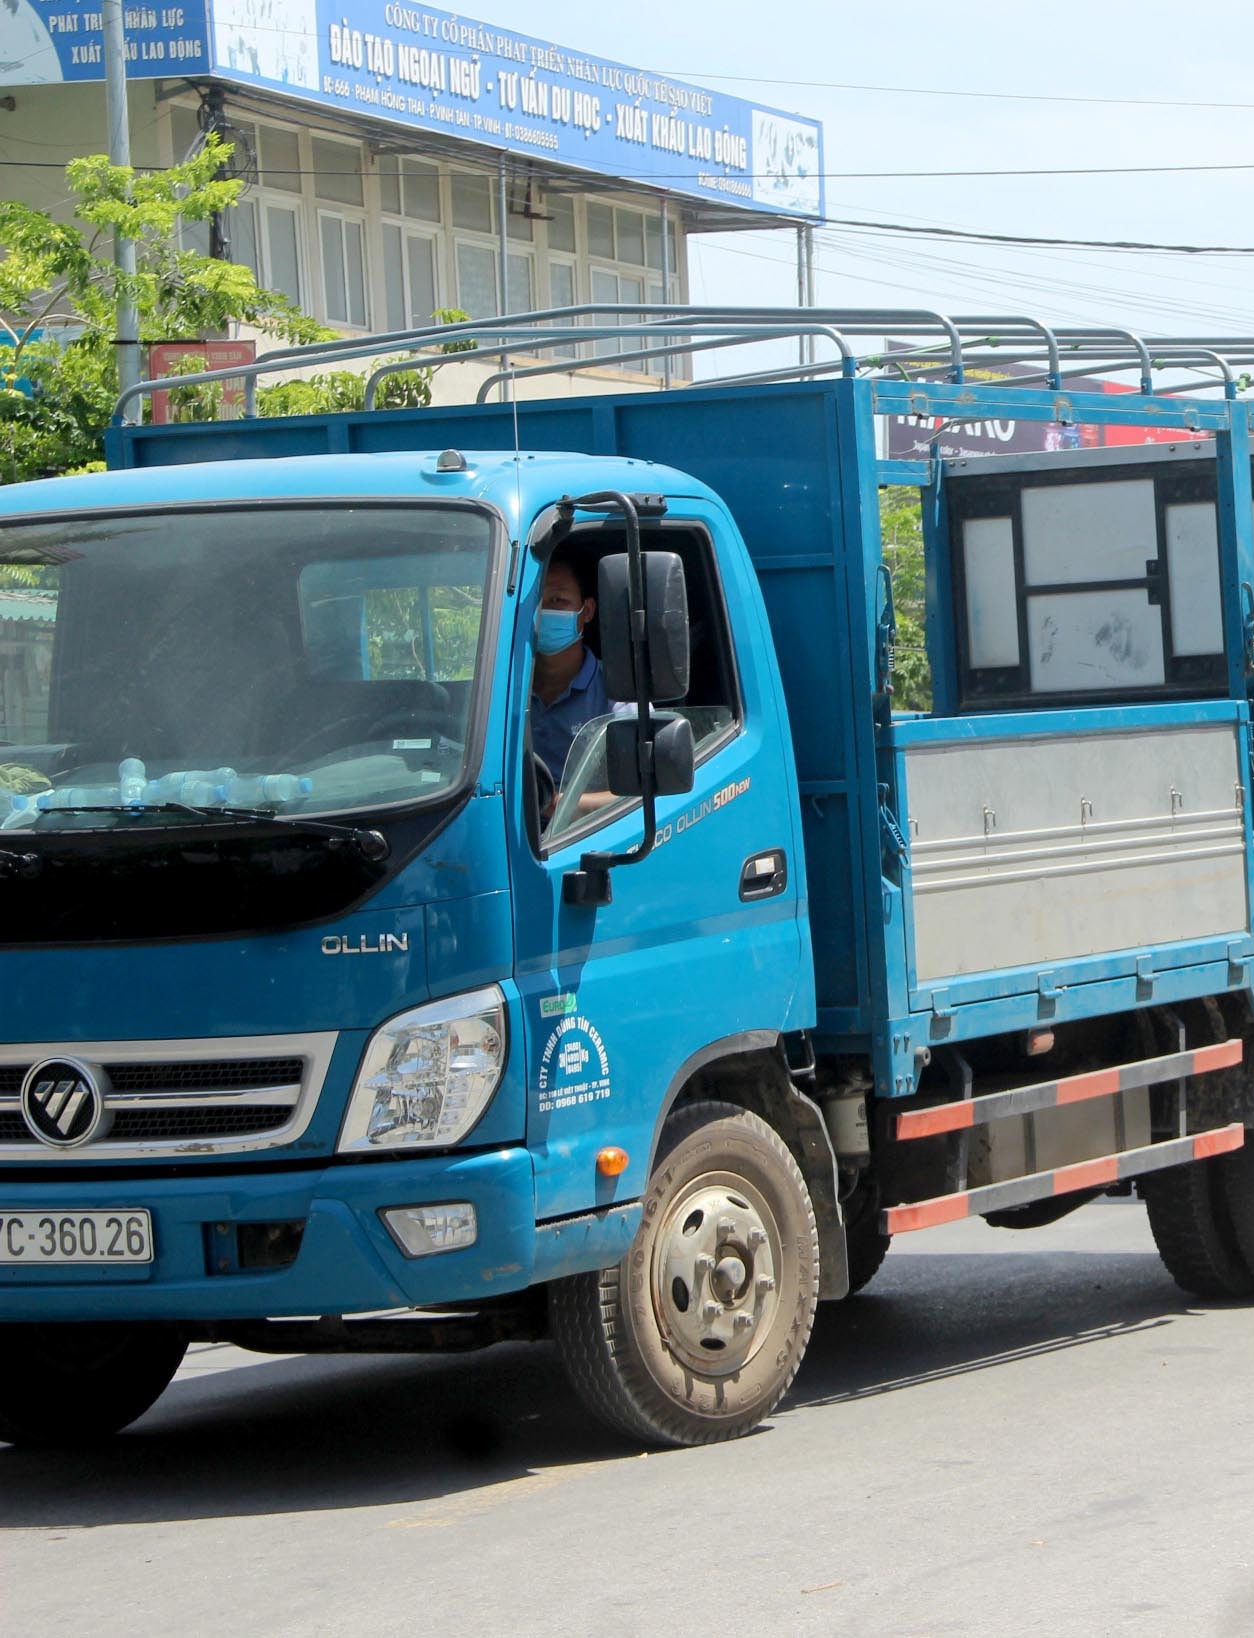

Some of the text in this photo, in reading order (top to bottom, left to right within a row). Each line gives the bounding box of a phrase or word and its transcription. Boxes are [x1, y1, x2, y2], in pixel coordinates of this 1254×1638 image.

[49, 6, 185, 34] PHÁT TRI NHÂN LỰC
[72, 39, 101, 64] XUẤT
[142, 42, 165, 61] LAO
[169, 36, 202, 62] ĐỘNG
[385, 2, 420, 32] CÔNG
[423, 14, 439, 38] TY
[441, 15, 457, 44] CỔ
[460, 24, 494, 53] PHẦN
[567, 57, 599, 84] NHÂN
[602, 66, 622, 92] LỰC
[624, 70, 651, 98] QUỐC
[654, 79, 668, 103] TẾ
[690, 90, 712, 116] VIỆT
[329, 16, 363, 69] ĐÀO
[365, 33, 394, 83] TẠO
[398, 43, 446, 97] NGOẠI
[449, 54, 482, 100] NGỮ
[498, 71, 518, 110] TƯ
[520, 66, 548, 117] VẤN
[551, 85, 571, 123] DU
[573, 91, 601, 137] HỌC
[615, 97, 649, 144] XUẤT
[651, 106, 685, 154] KHẨU
[688, 123, 712, 162] LAO
[714, 124, 747, 174] ĐỘNG
[335, 79, 350, 97] 666
[355, 84, 379, 105] PHẠM
[381, 87, 406, 111] HỒNG
[676, 799, 712, 834] OLLIN
[321, 932, 409, 955] OLLIN
[542, 1032, 559, 1063] TNHH
[588, 1026, 609, 1076] CERAMIC
[539, 1066, 548, 1089] CTY
[556, 1095, 577, 1109] 0968
[578, 1091, 594, 1104] 619
[595, 1088, 611, 1100] 719
[0, 1216, 145, 1257] C-360.26
